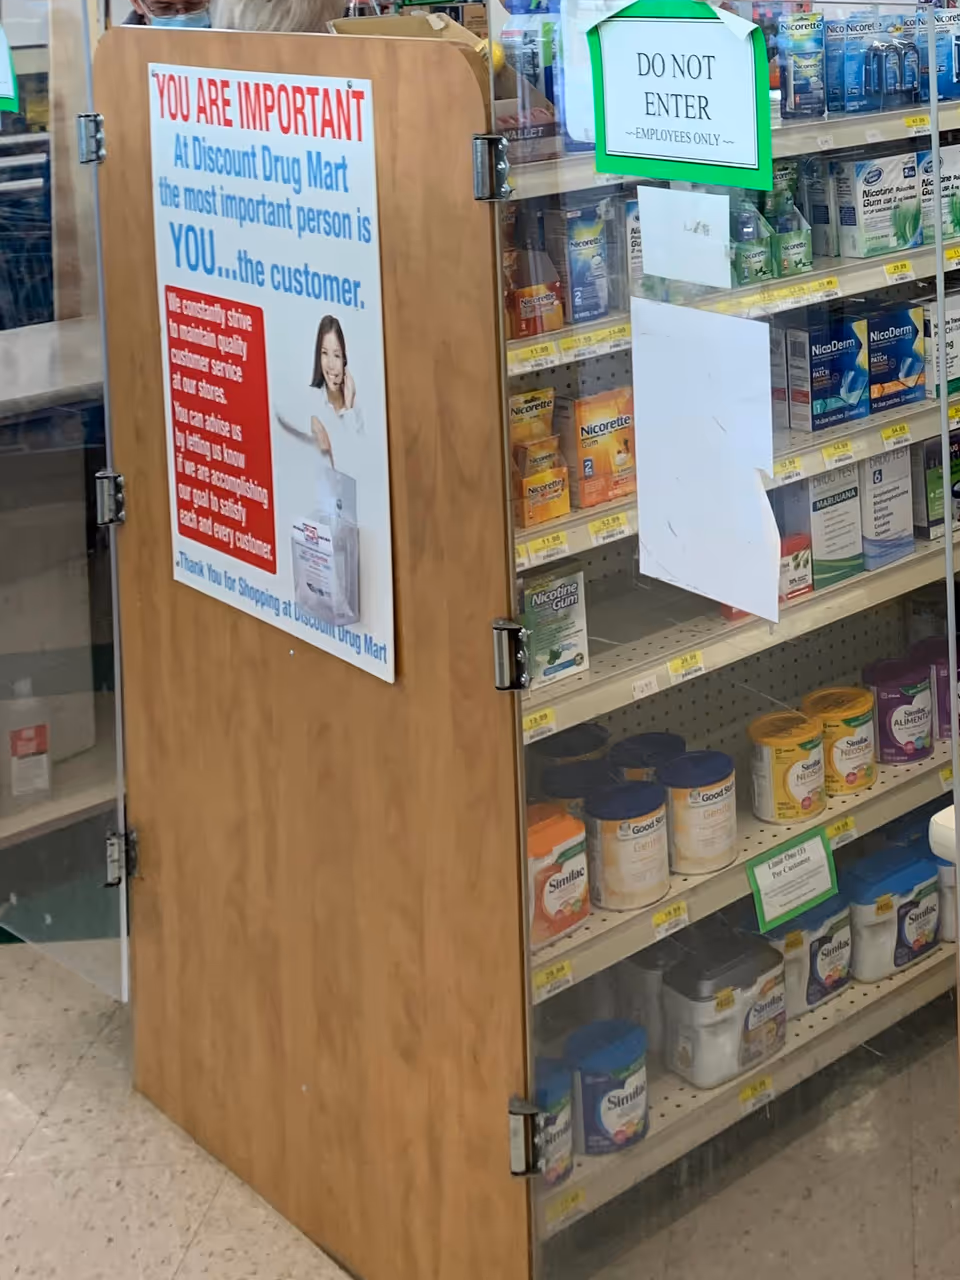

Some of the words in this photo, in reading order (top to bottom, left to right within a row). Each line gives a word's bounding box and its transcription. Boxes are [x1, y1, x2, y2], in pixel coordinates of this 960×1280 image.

[780, 21, 823, 32] Nicorette
[636, 52, 666, 78] DO
[671, 54, 716, 80] NOT
[155, 72, 191, 122] YOU
[196, 77, 234, 128] ARE
[237, 80, 365, 142] IMPORTANT
[644, 91, 712, 121] ENTER
[693, 133, 721, 147] ONLY
[174, 132, 189, 169] At
[193, 134, 258, 180] Discount
[261, 144, 302, 195] Drug
[306, 150, 349, 194] Mart
[863, 186, 894, 199] Nicotine
[159, 176, 180, 209] the
[184, 184, 218, 217] most
[220, 187, 293, 230] important
[296, 203, 352, 240] person
[356, 207, 372, 244] is
[270, 262, 365, 310] customer.
[167, 291, 181, 313] We
[182, 300, 226, 329] constantly
[227, 308, 253, 332] strive
[169, 318, 179, 339] to
[179, 322, 217, 349] maintain
[218, 334, 248, 362] quality
[812, 338, 856, 357] NicoDerm
[870, 325, 913, 343] NicoDerm
[171, 348, 210, 373] customer
[211, 358, 243, 383] service
[172, 371, 182, 391] at
[182, 376, 197, 395] our
[198, 378, 228, 405] stores.
[173, 400, 188, 424] You
[189, 410, 204, 429] can
[205, 412, 231, 438] advise
[231, 422, 243, 442] us
[510, 398, 553, 417] Nicorette
[580, 414, 631, 438] Nicorette
[175, 426, 185, 452] by
[186, 429, 212, 462] letting
[212, 443, 222, 462] us
[223, 443, 246, 469] know
[581, 439, 599, 449] Gum
[176, 452, 184, 472] if
[184, 459, 196, 477] we
[197, 464, 210, 483] are
[211, 469, 269, 509] accomplishing
[815, 488, 857, 511] MARIJUANA
[179, 551, 205, 577] Thank
[206, 561, 222, 585] You
[223, 570, 237, 591] for
[238, 579, 280, 617] Shopping
[281, 599, 293, 619] at
[338, 624, 362, 655] Drug
[363, 633, 388, 665] Mart
[531, 580, 578, 608] Nicotine
[552, 592, 579, 612] Gum
[701, 790, 724, 802] Good
[548, 865, 585, 894] Similac
[908, 903, 938, 926] Similac
[821, 937, 850, 962] Similac
[753, 992, 784, 1014] Similac
